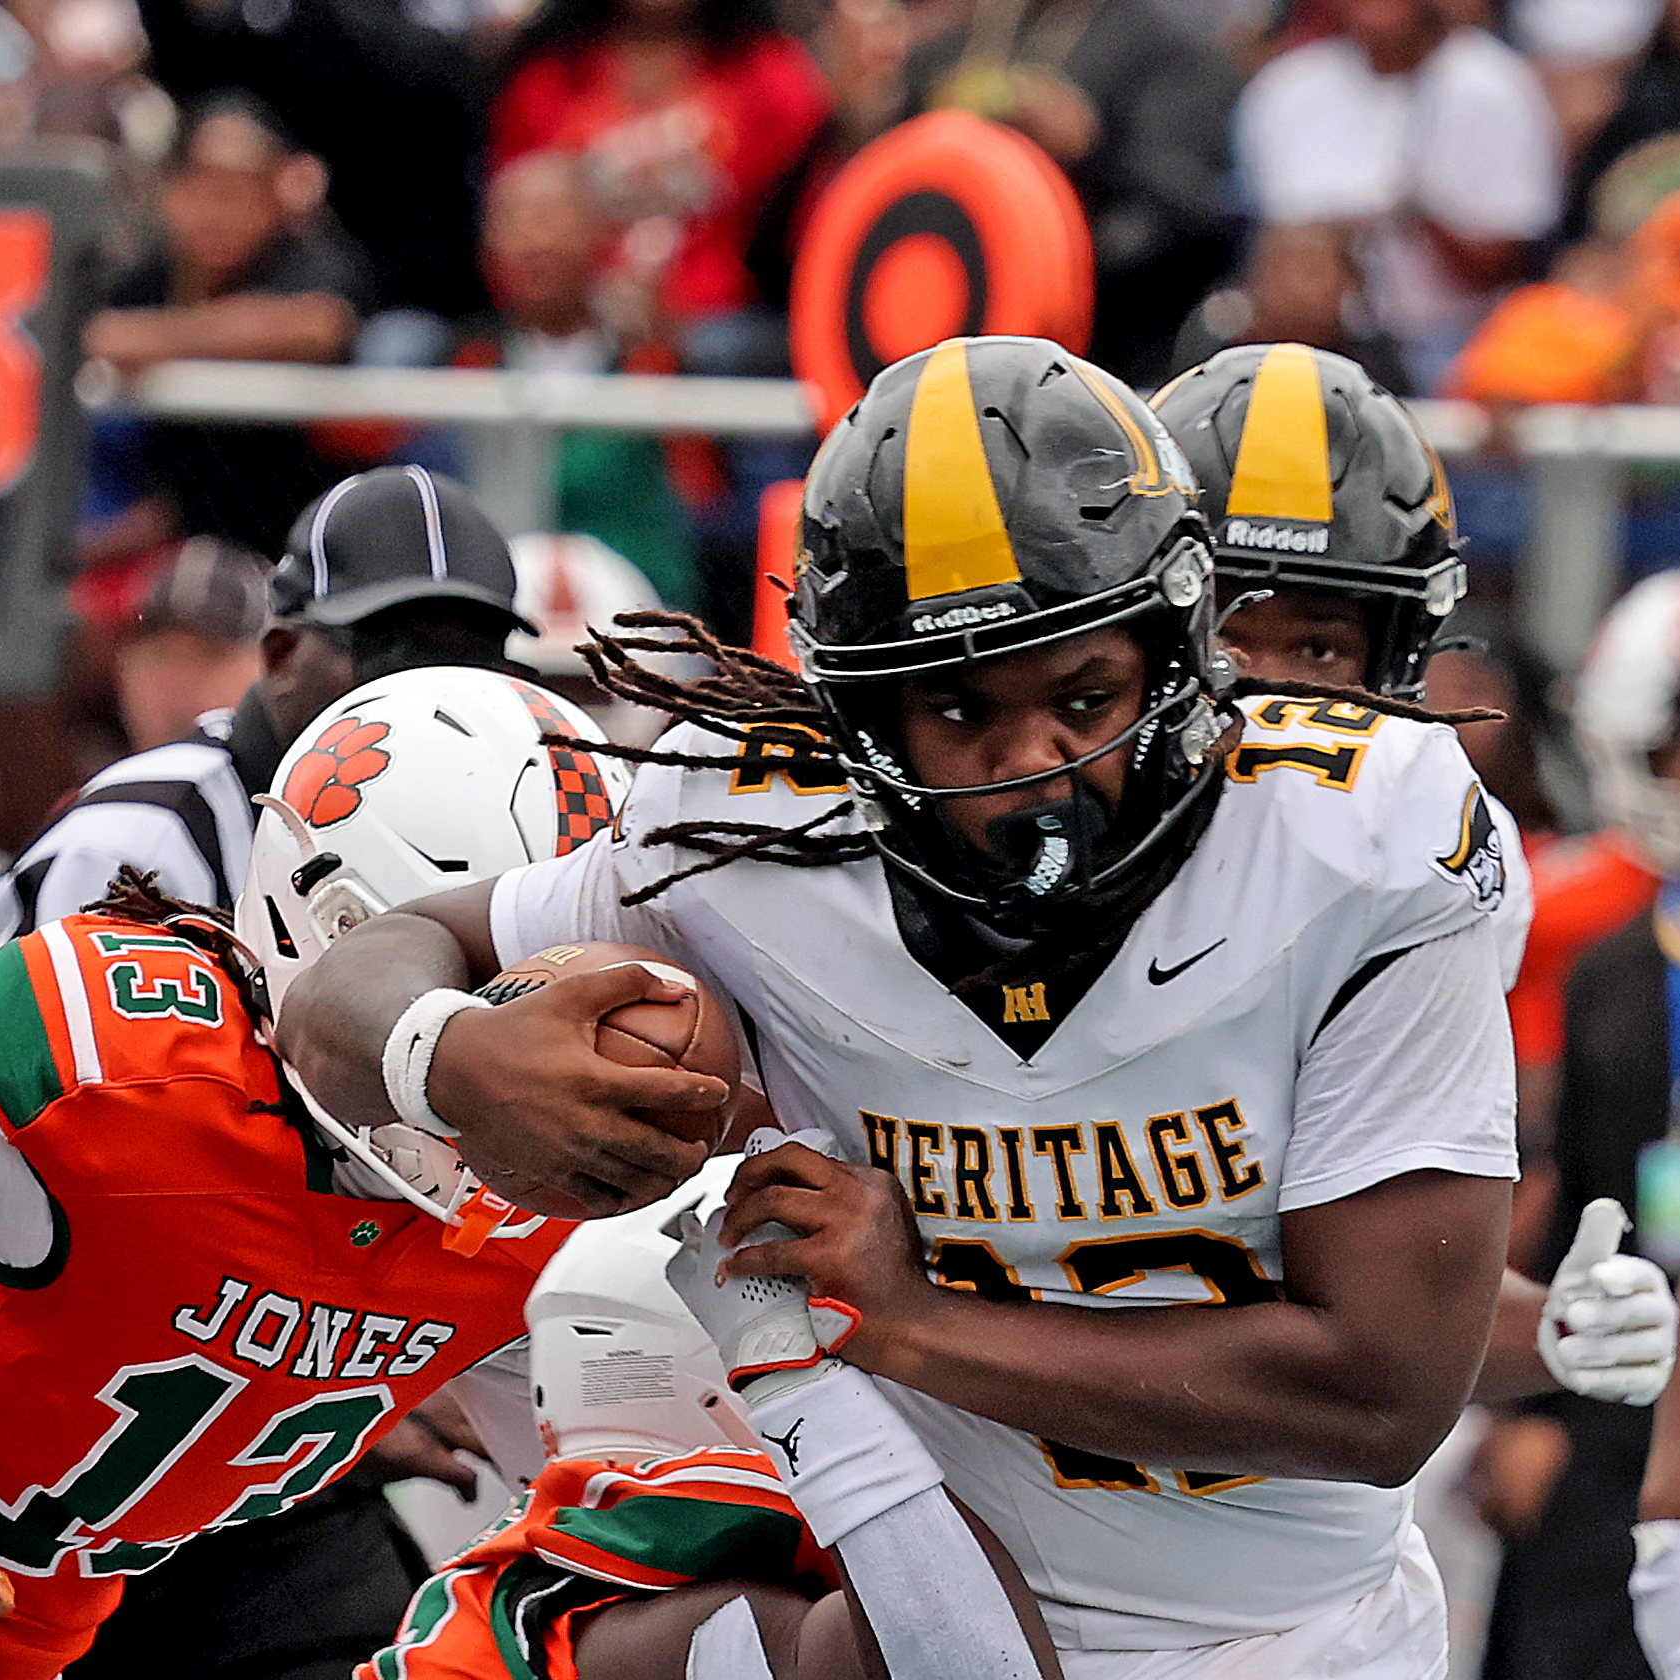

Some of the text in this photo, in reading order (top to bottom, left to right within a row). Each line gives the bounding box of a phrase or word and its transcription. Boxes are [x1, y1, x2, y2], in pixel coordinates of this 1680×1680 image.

[1226, 520, 1329, 554] Riddell
[88, 931, 225, 1029] 13
[859, 1097, 1266, 1223] HERITAGE
[171, 1275, 456, 1381] JONES
